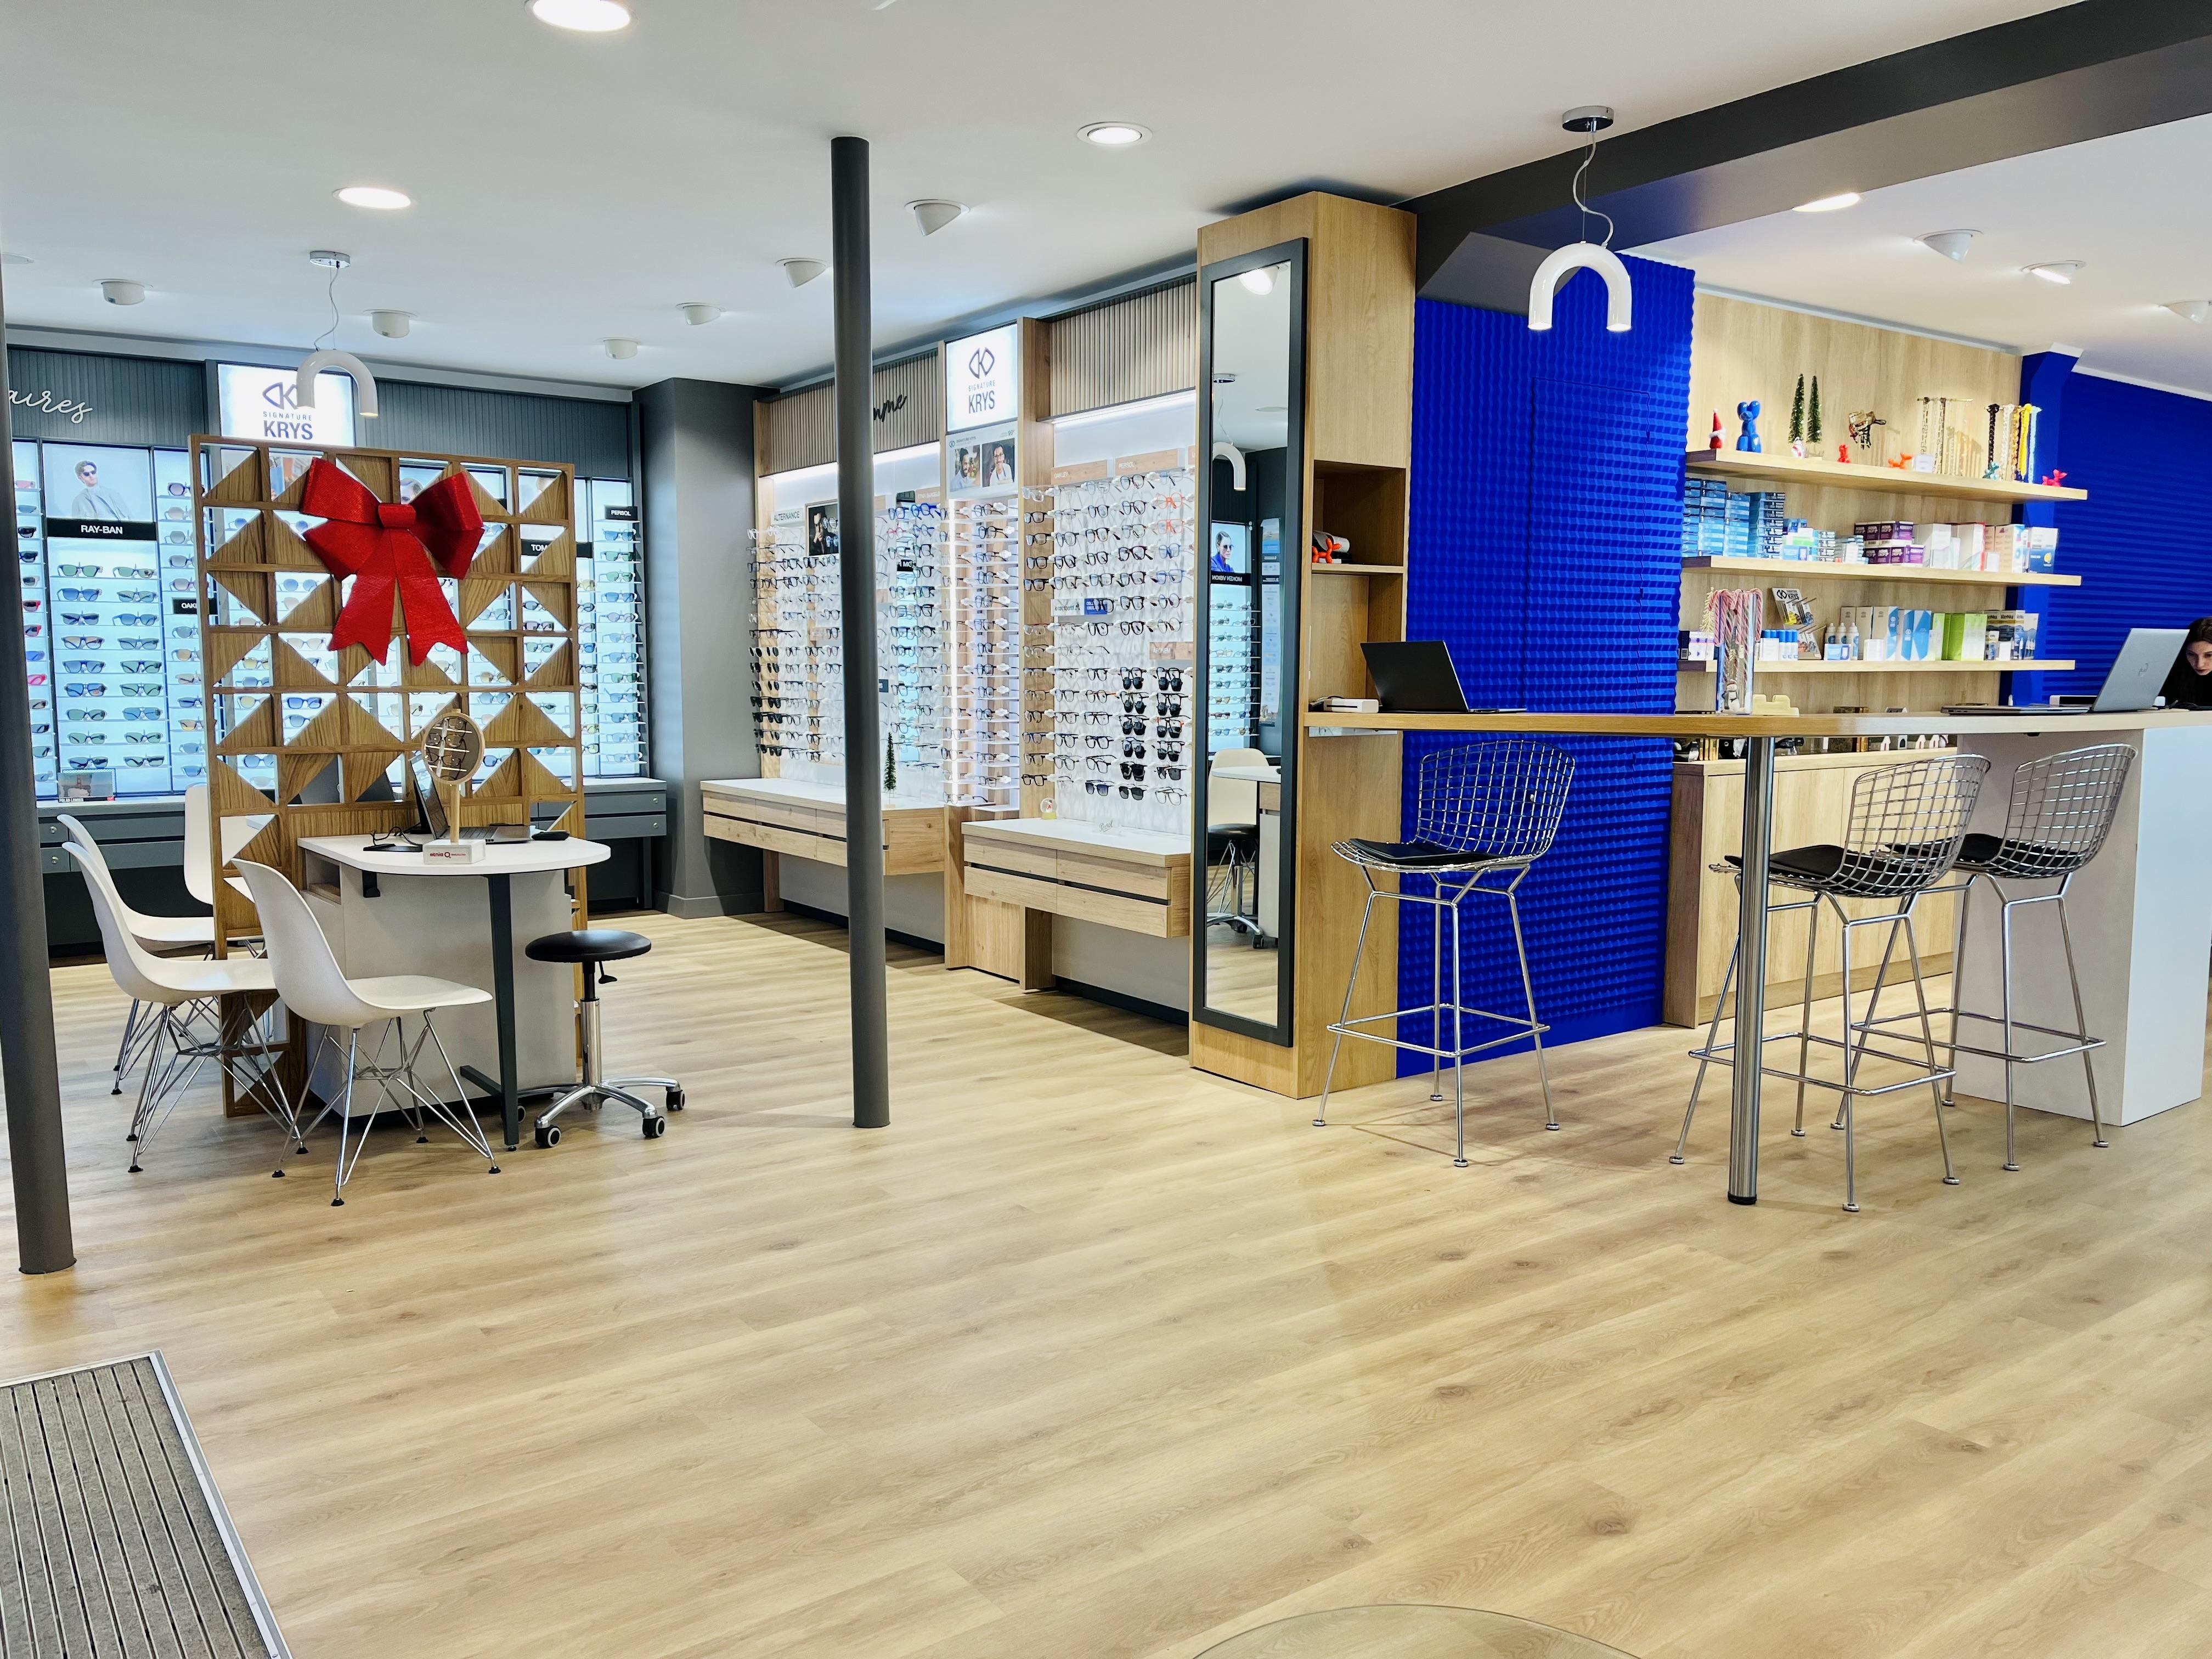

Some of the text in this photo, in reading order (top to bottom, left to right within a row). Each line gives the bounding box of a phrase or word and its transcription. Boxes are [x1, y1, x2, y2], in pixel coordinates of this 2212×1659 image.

[968, 380, 995, 392] SIGNATURE
[9, 390, 93, 424] aires
[968, 390, 995, 414] KRYS
[263, 411, 312, 421] SIGNATURE
[263, 420, 313, 441] KRYS
[774, 511, 800, 522] ALTERNANCE
[81, 524, 123, 534] RAY-BAN
